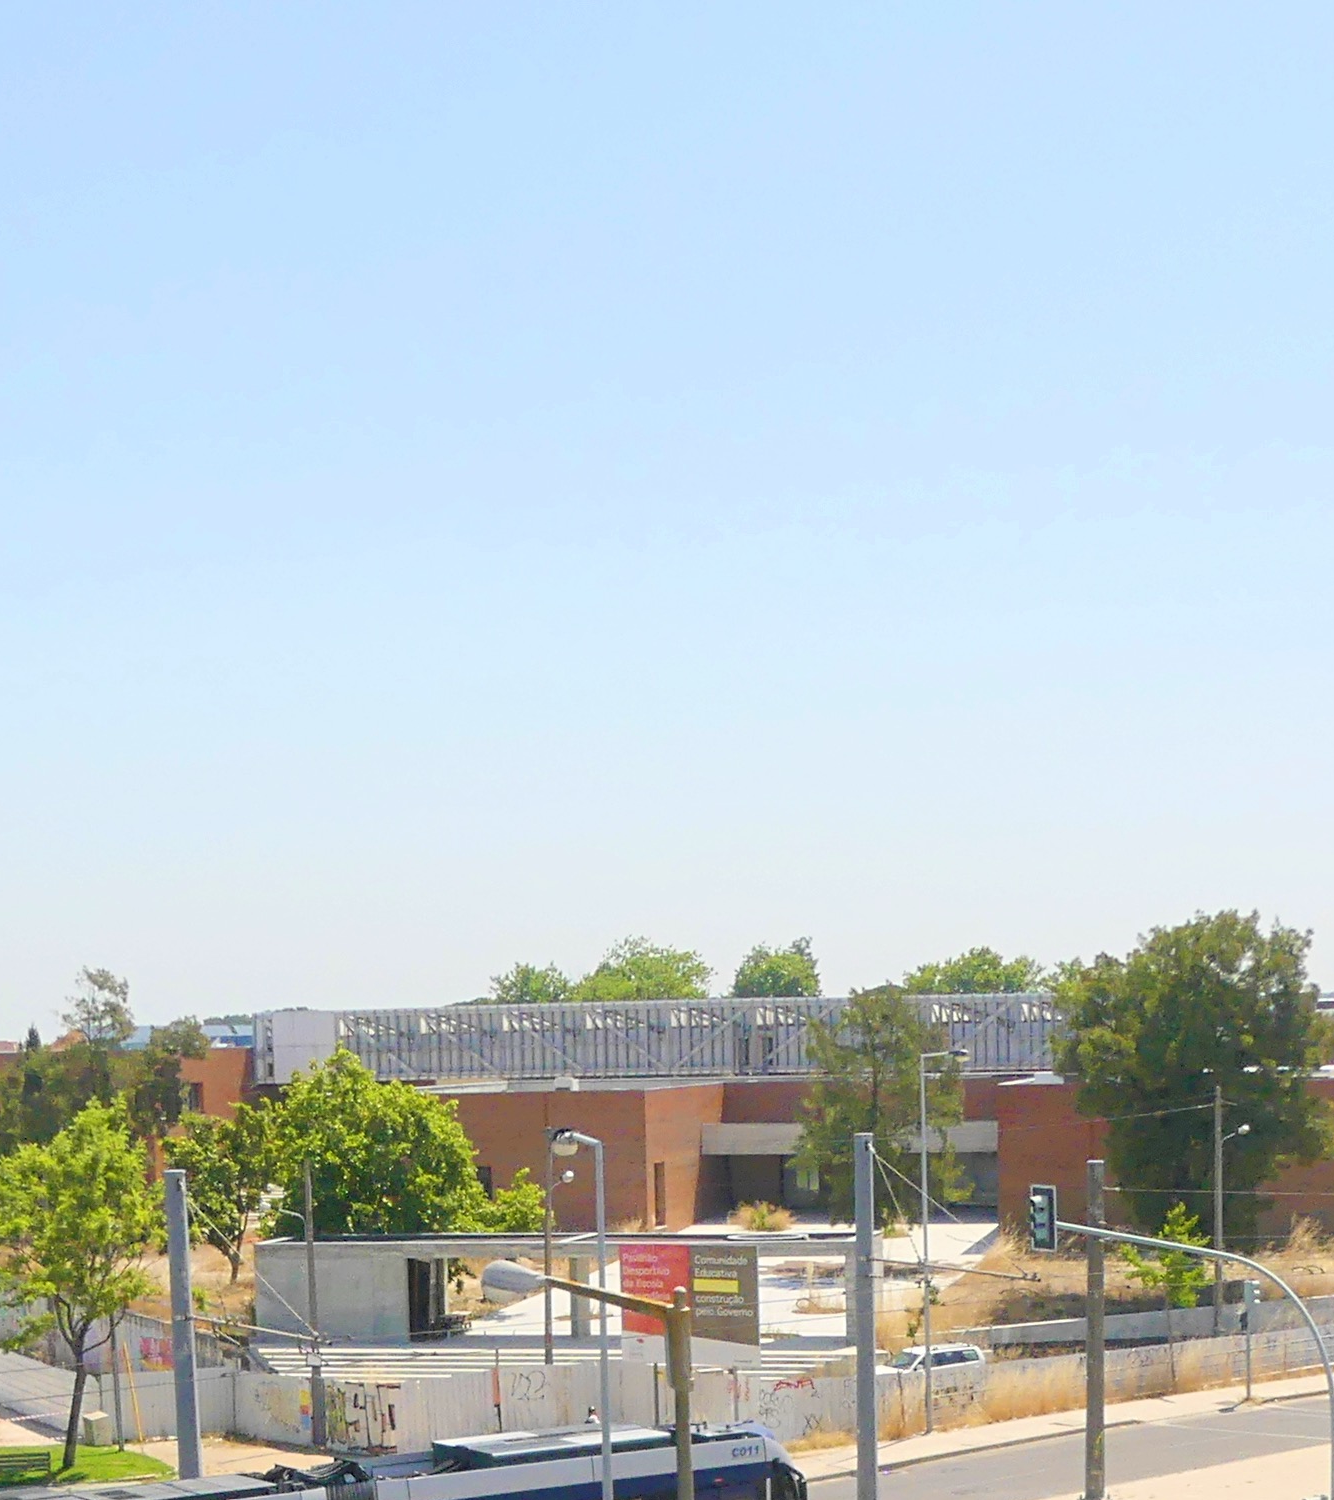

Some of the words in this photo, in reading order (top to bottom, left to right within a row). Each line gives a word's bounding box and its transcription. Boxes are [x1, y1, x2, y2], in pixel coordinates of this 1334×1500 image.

[694, 1254, 748, 1266] Comunidade
[694, 1267, 738, 1278] Educativa
[695, 1294, 744, 1305] construção
[717, 1306, 754, 1317] Governo
[731, 1445, 759, 1457] C011
